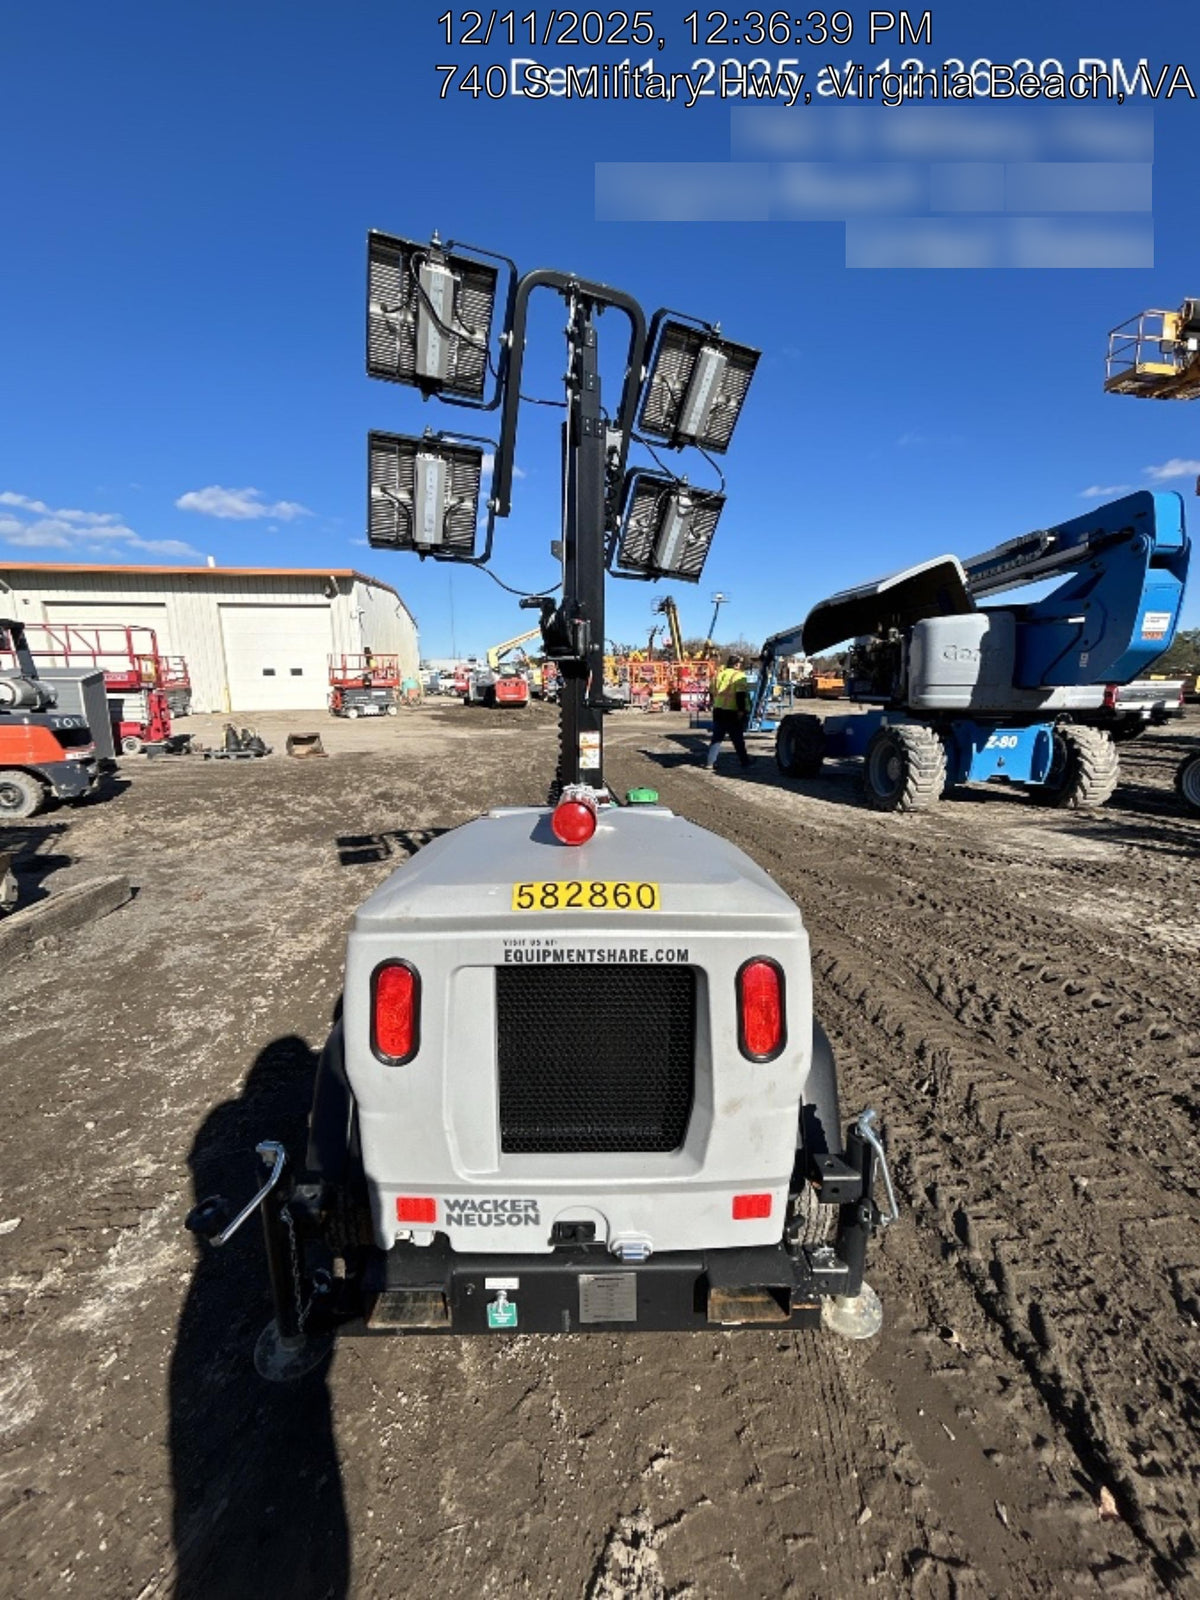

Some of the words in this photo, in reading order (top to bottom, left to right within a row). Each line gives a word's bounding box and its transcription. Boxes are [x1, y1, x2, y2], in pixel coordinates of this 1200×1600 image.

[985, 735, 1018, 749] Z-80
[516, 881, 656, 909] 582860
[504, 948, 689, 963] EQUIPMENTSHARE.COM
[444, 1199, 540, 1213] WACKER
[445, 1213, 541, 1226] NEUSON
